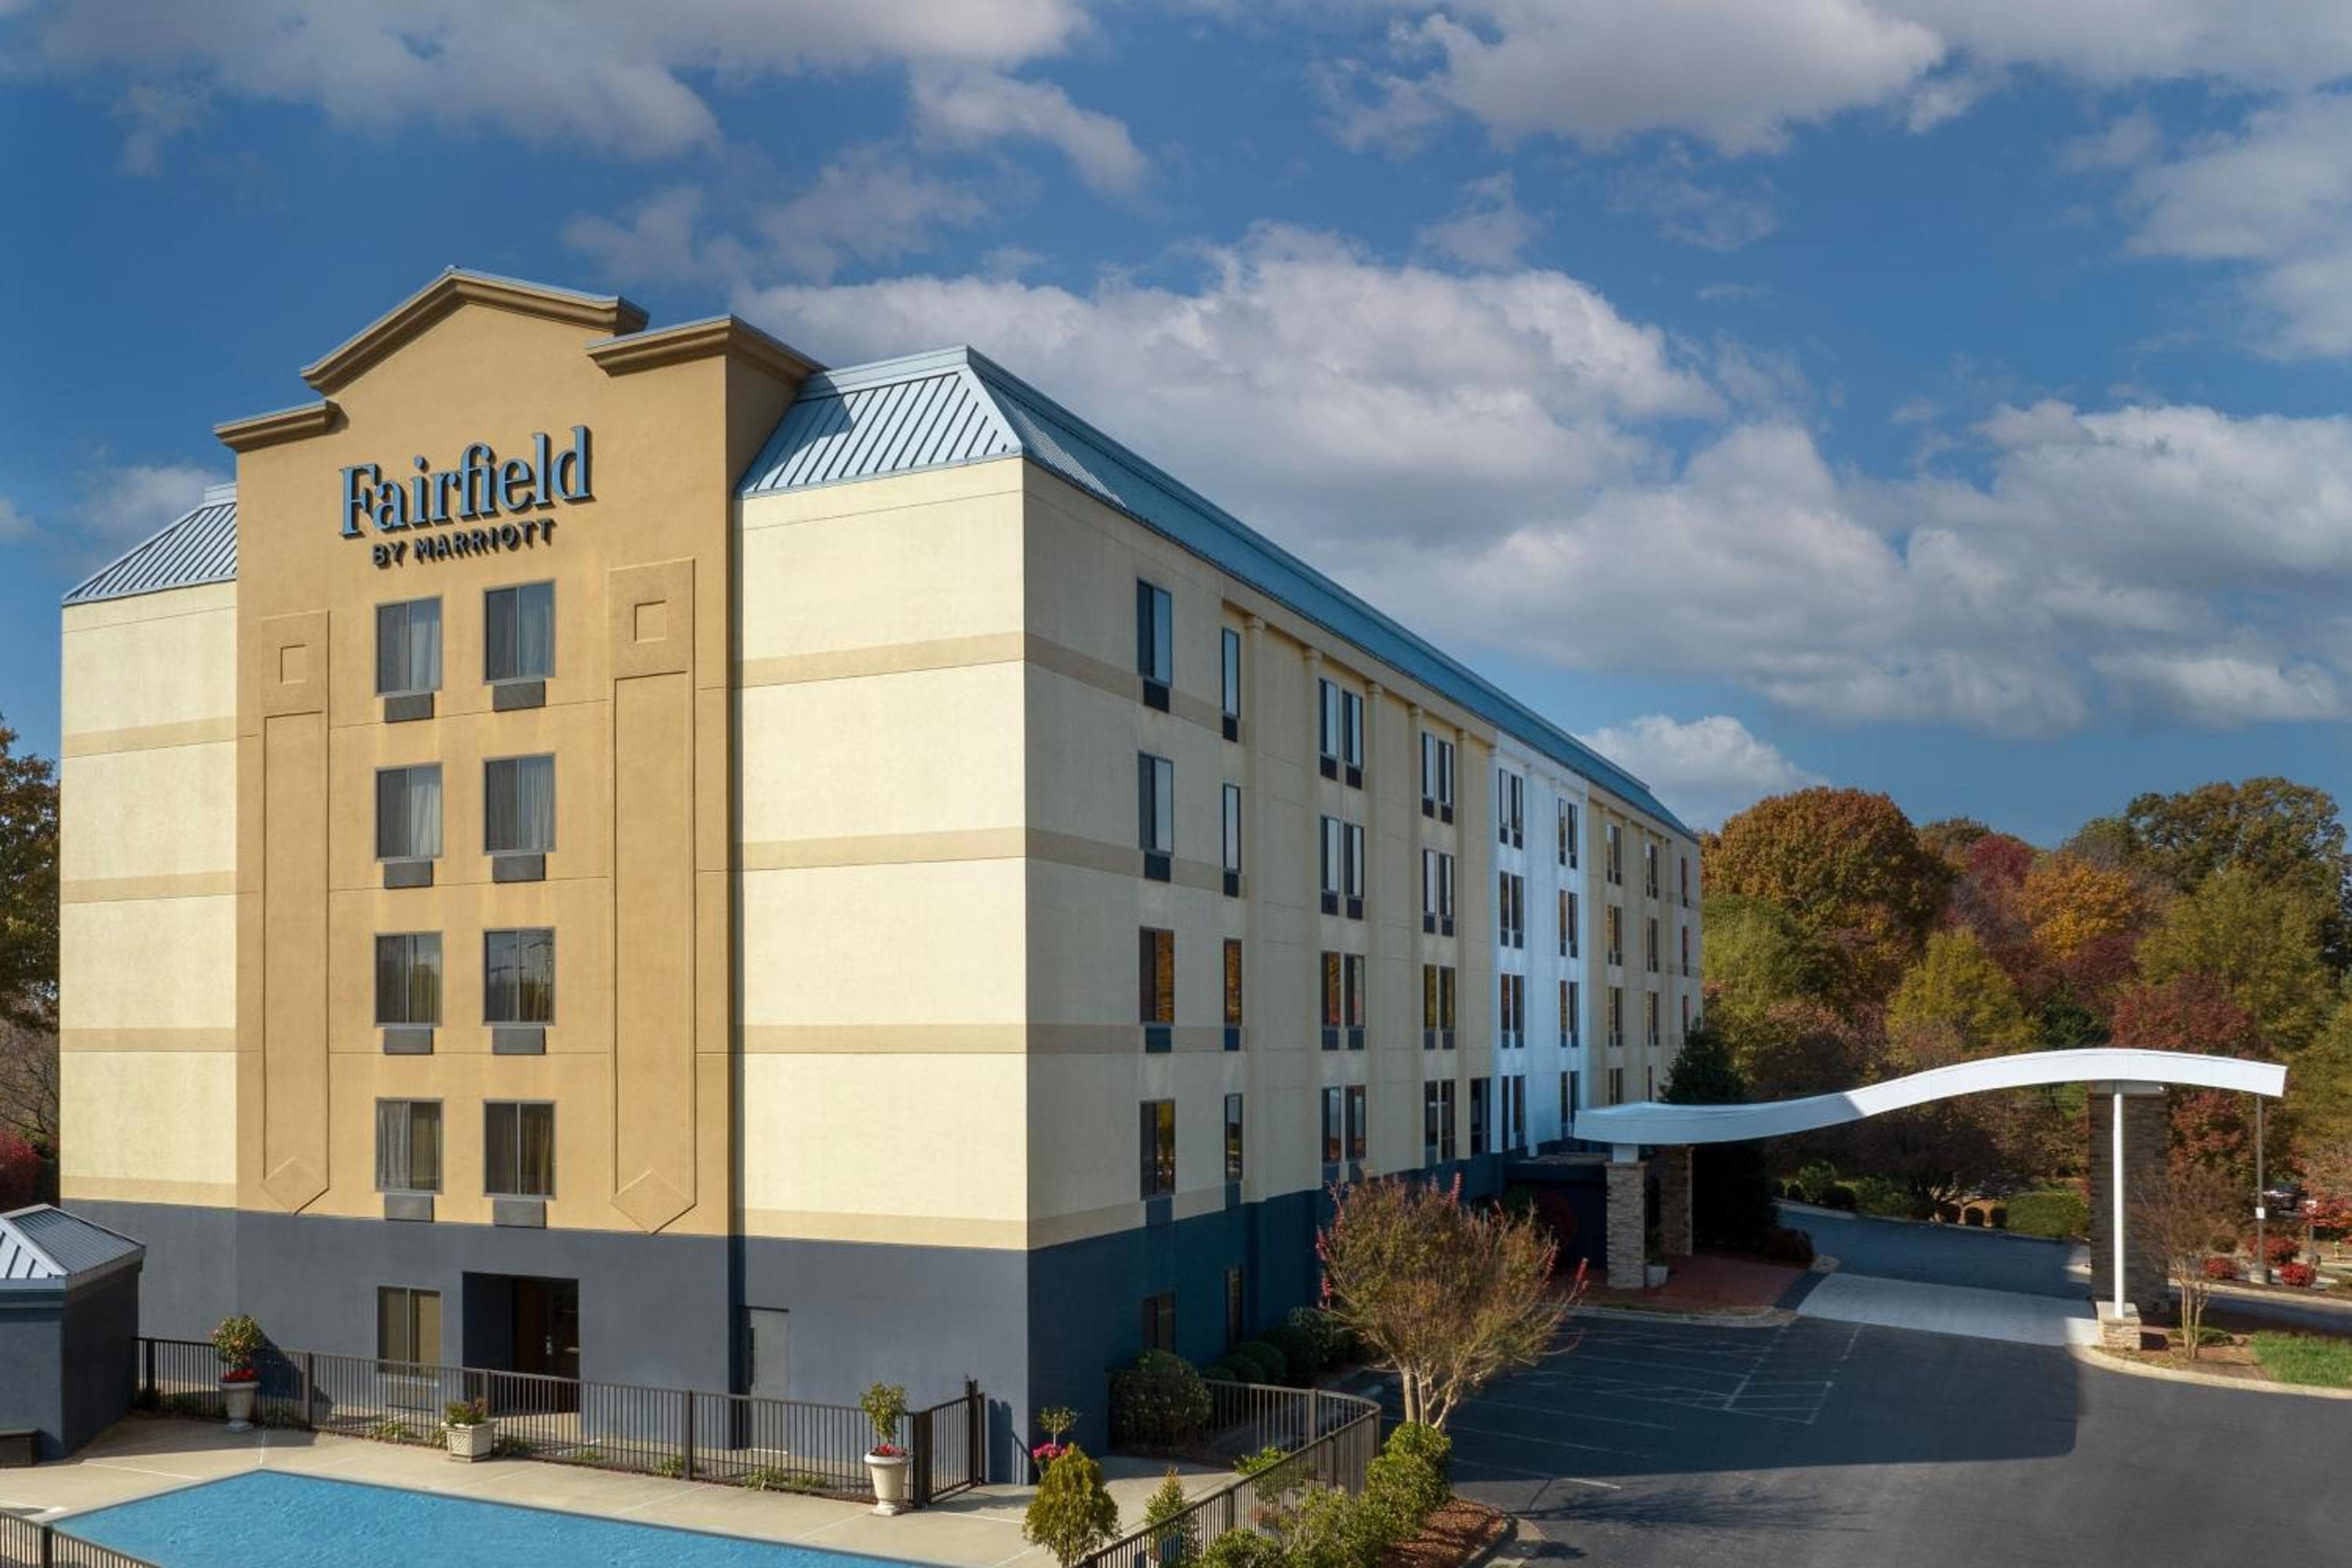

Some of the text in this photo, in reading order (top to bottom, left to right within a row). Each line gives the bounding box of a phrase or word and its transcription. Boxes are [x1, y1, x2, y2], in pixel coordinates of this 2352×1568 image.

[339, 425, 594, 538] Fairfield
[372, 518, 557, 568] BY MARRIOTT
